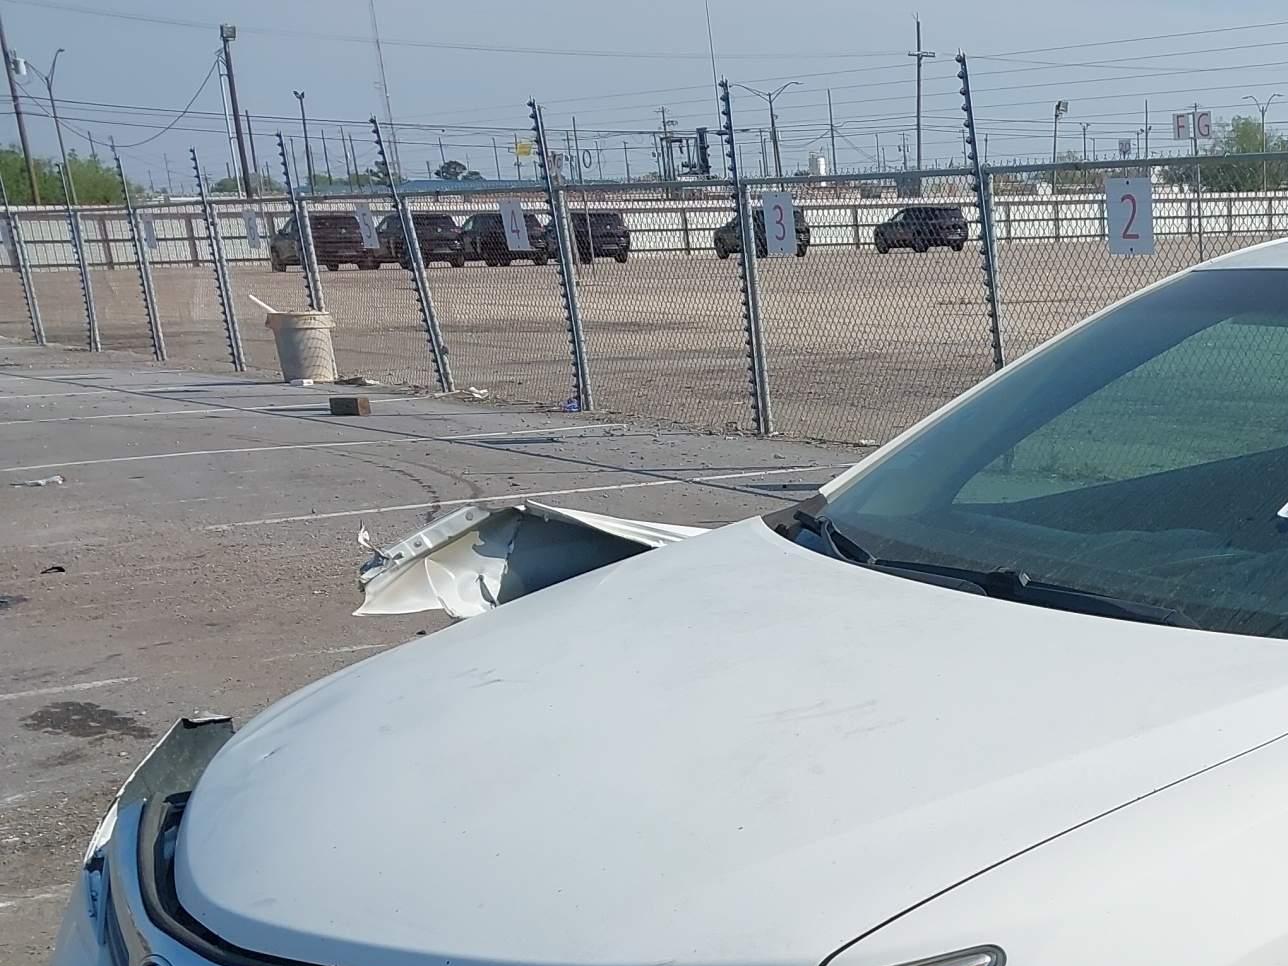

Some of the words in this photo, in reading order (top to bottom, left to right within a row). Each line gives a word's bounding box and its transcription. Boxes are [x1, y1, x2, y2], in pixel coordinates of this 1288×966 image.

[1176, 114, 1185, 138] F
[1197, 112, 1210, 137] G
[362, 212, 373, 239] 5
[510, 209, 521, 240] 4
[773, 204, 786, 241] 3
[1121, 194, 1140, 239] 2
